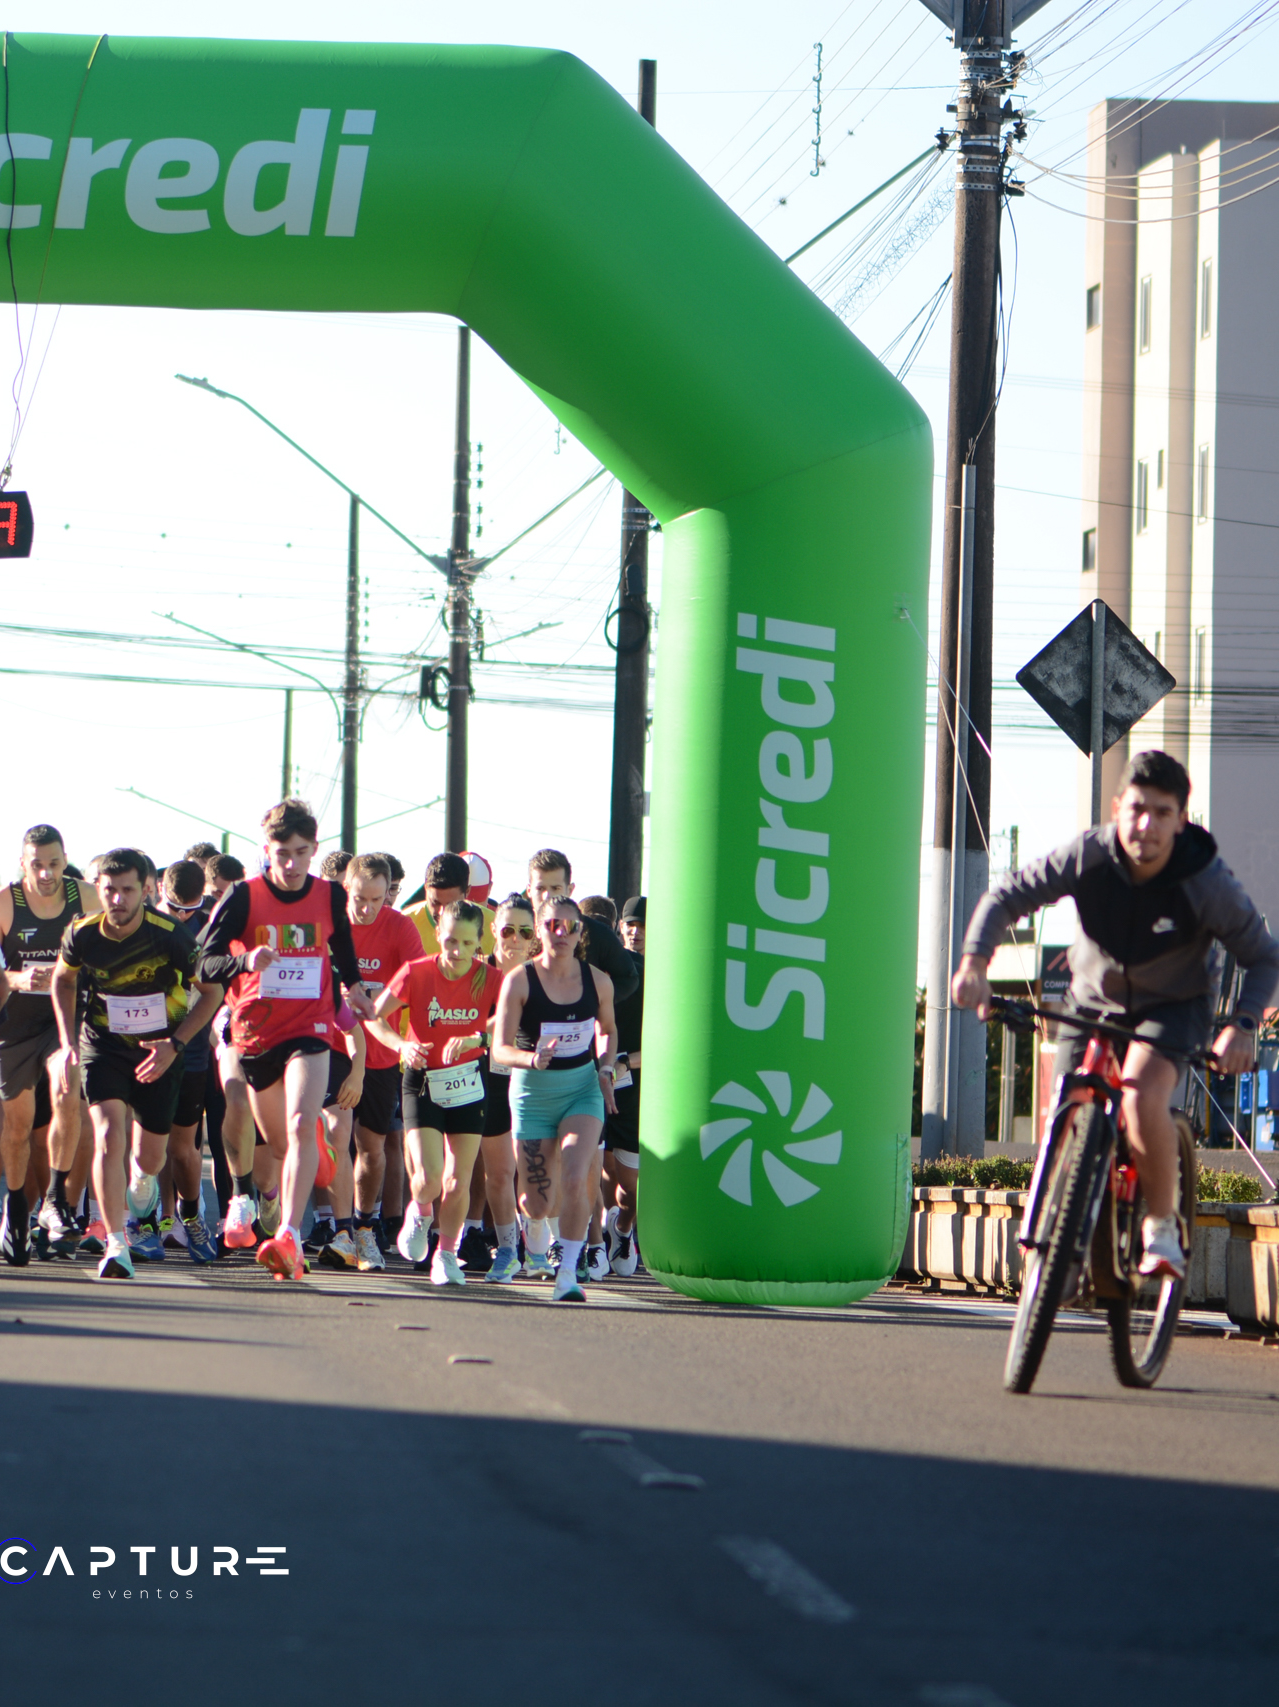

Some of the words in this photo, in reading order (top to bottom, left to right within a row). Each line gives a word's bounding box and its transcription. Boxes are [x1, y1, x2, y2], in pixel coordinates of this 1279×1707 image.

[725, 613, 836, 1040] Sicredi
[18, 949, 63, 958] TITANI
[357, 957, 381, 970] SLO
[278, 970, 305, 980] 072
[124, 1008, 149, 1018] 173
[434, 1008, 479, 1020] AASLO
[557, 1033, 581, 1043] 125
[444, 1077, 467, 1091] 201
